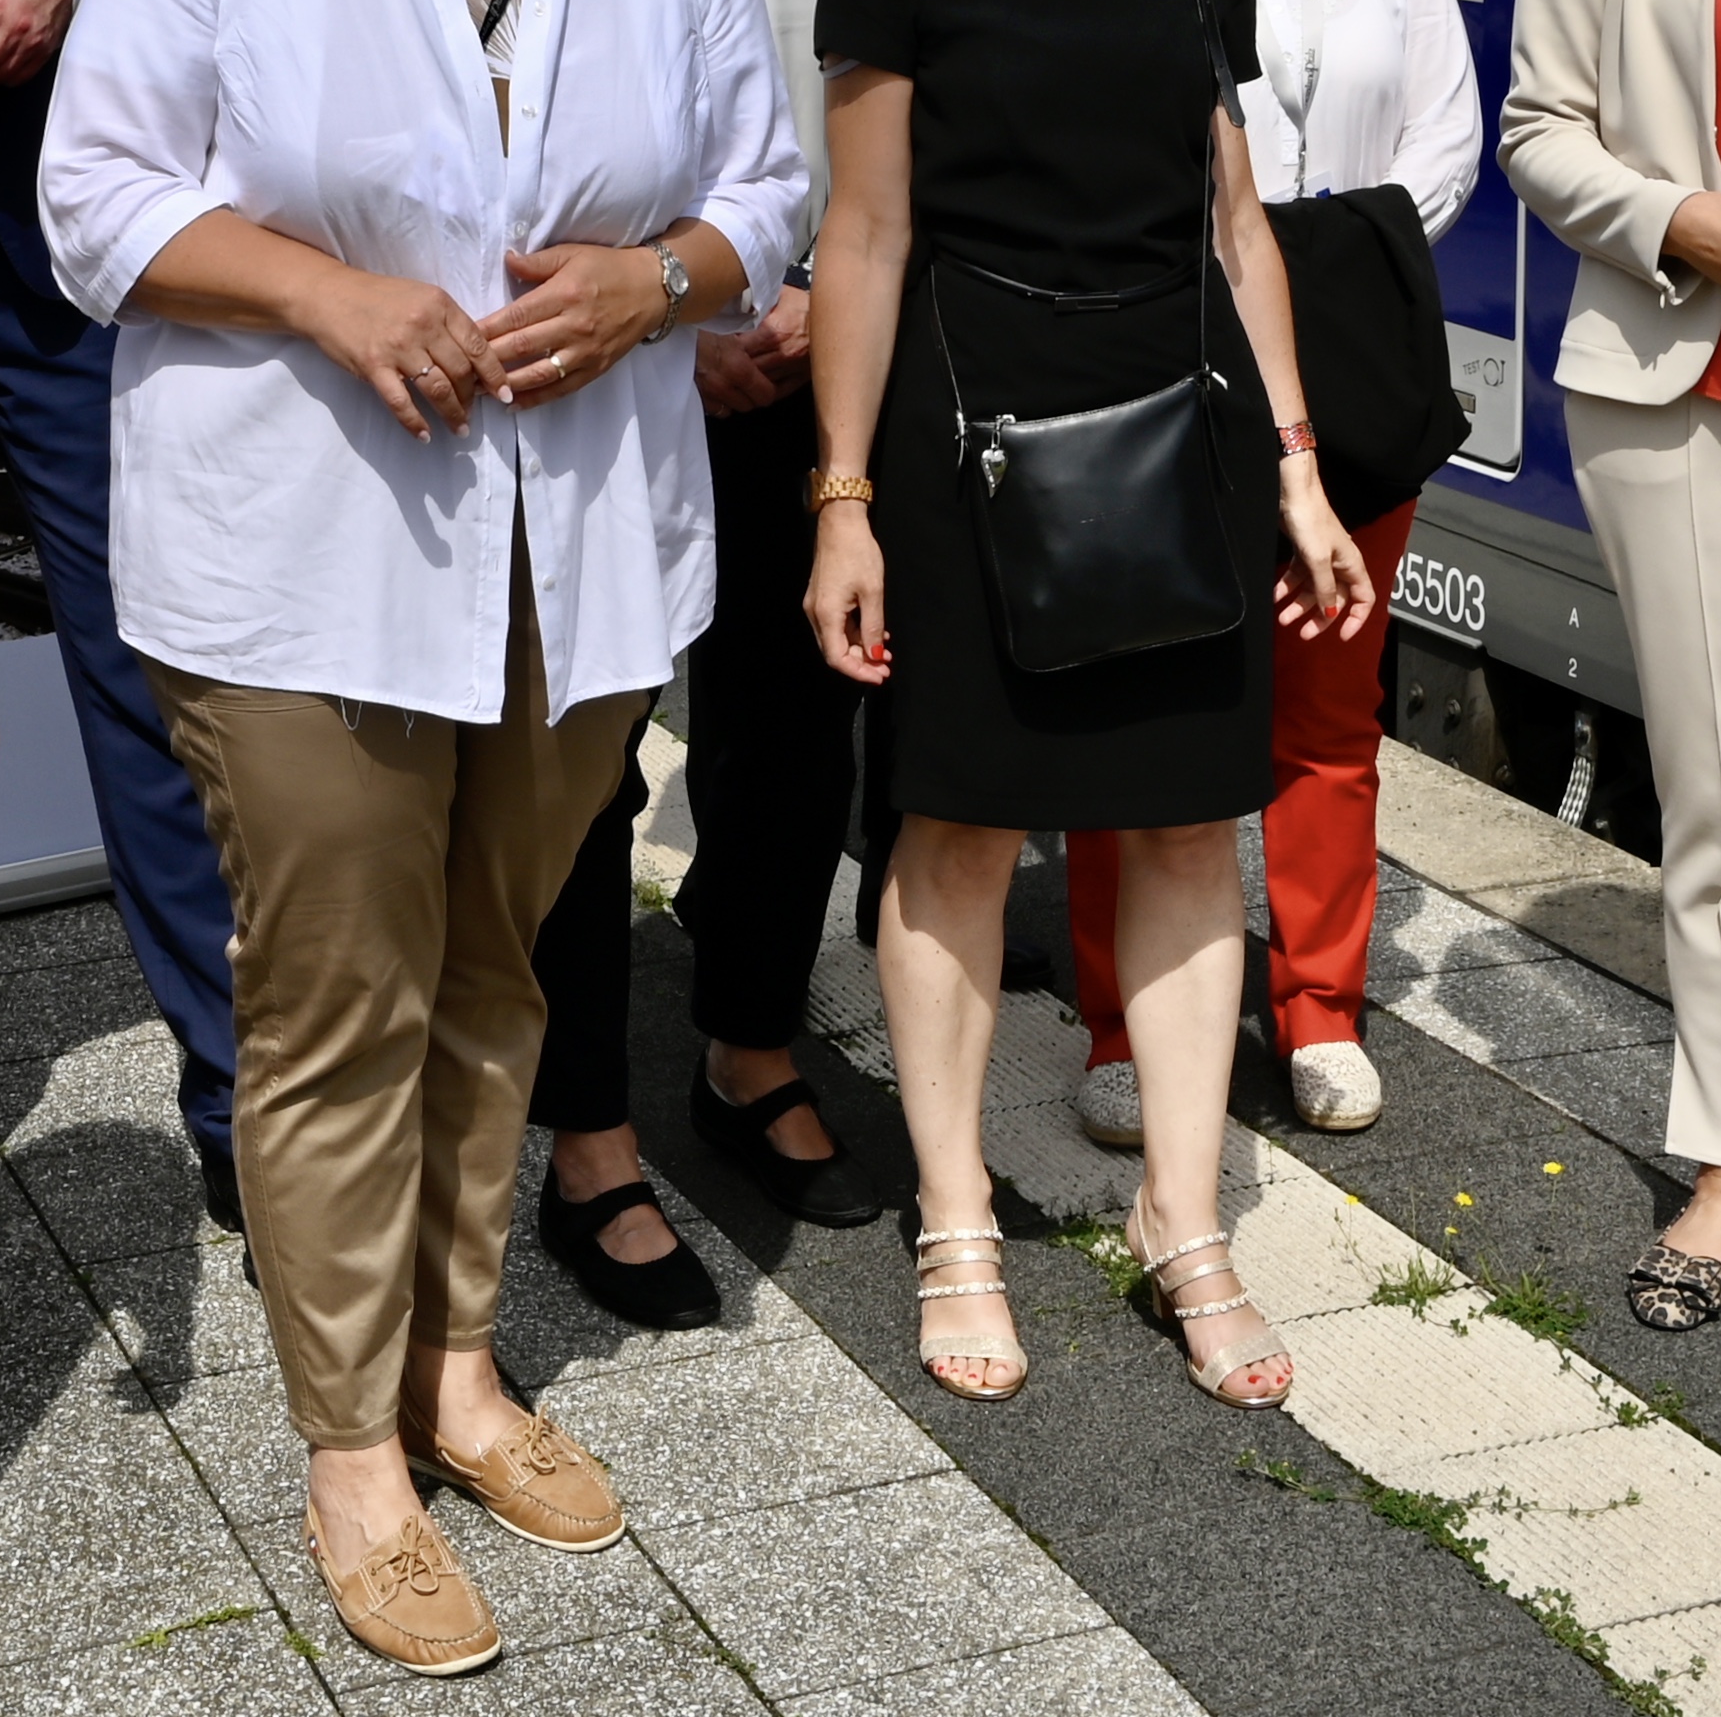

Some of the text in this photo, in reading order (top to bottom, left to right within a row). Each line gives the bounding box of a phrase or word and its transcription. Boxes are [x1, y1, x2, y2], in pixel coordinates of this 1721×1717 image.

[1462, 359, 1480, 376] TEST
[1569, 607, 1579, 628] A
[1568, 658, 1578, 678] 2
